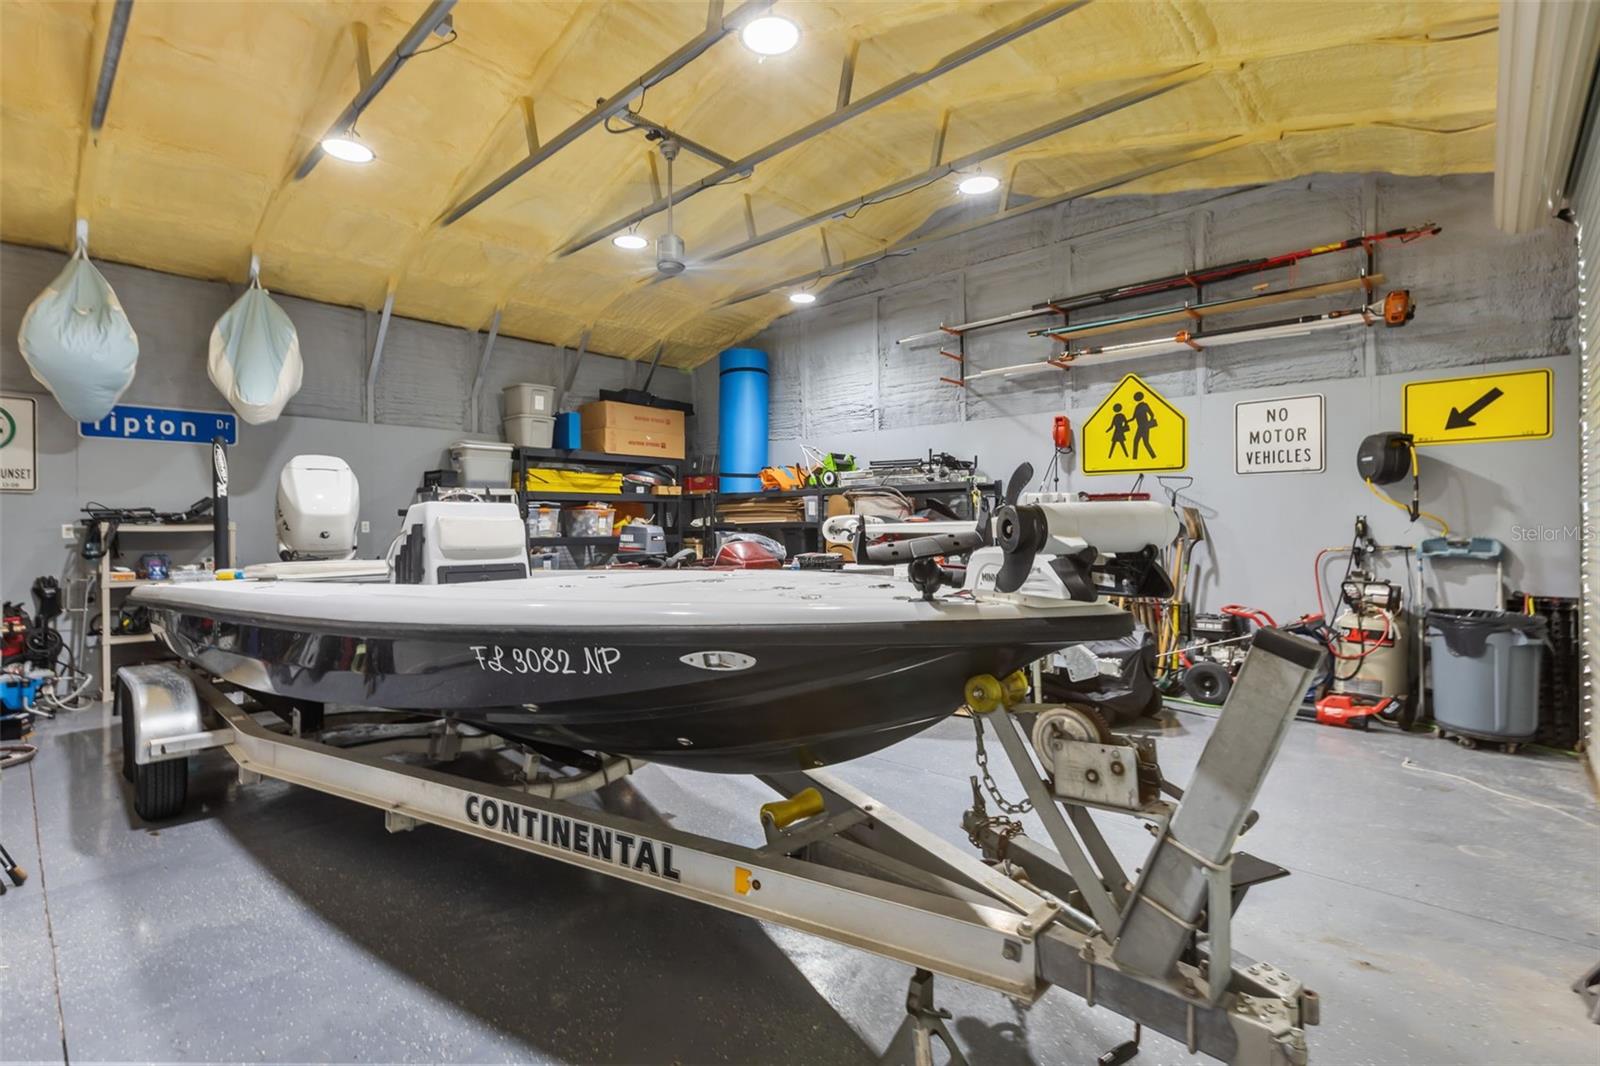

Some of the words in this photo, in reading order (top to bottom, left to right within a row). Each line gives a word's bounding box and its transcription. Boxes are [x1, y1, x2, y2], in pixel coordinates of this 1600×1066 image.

[1266, 407, 1289, 423] NO
[216, 419, 231, 430] Dr
[1249, 427, 1307, 445] MOTOR
[1246, 448, 1312, 465] VEHICLES
[0, 468, 31, 480] UNSET
[512, 646, 577, 674] 3082
[583, 646, 621, 675] NP
[464, 794, 681, 883] CONTINENTAL
